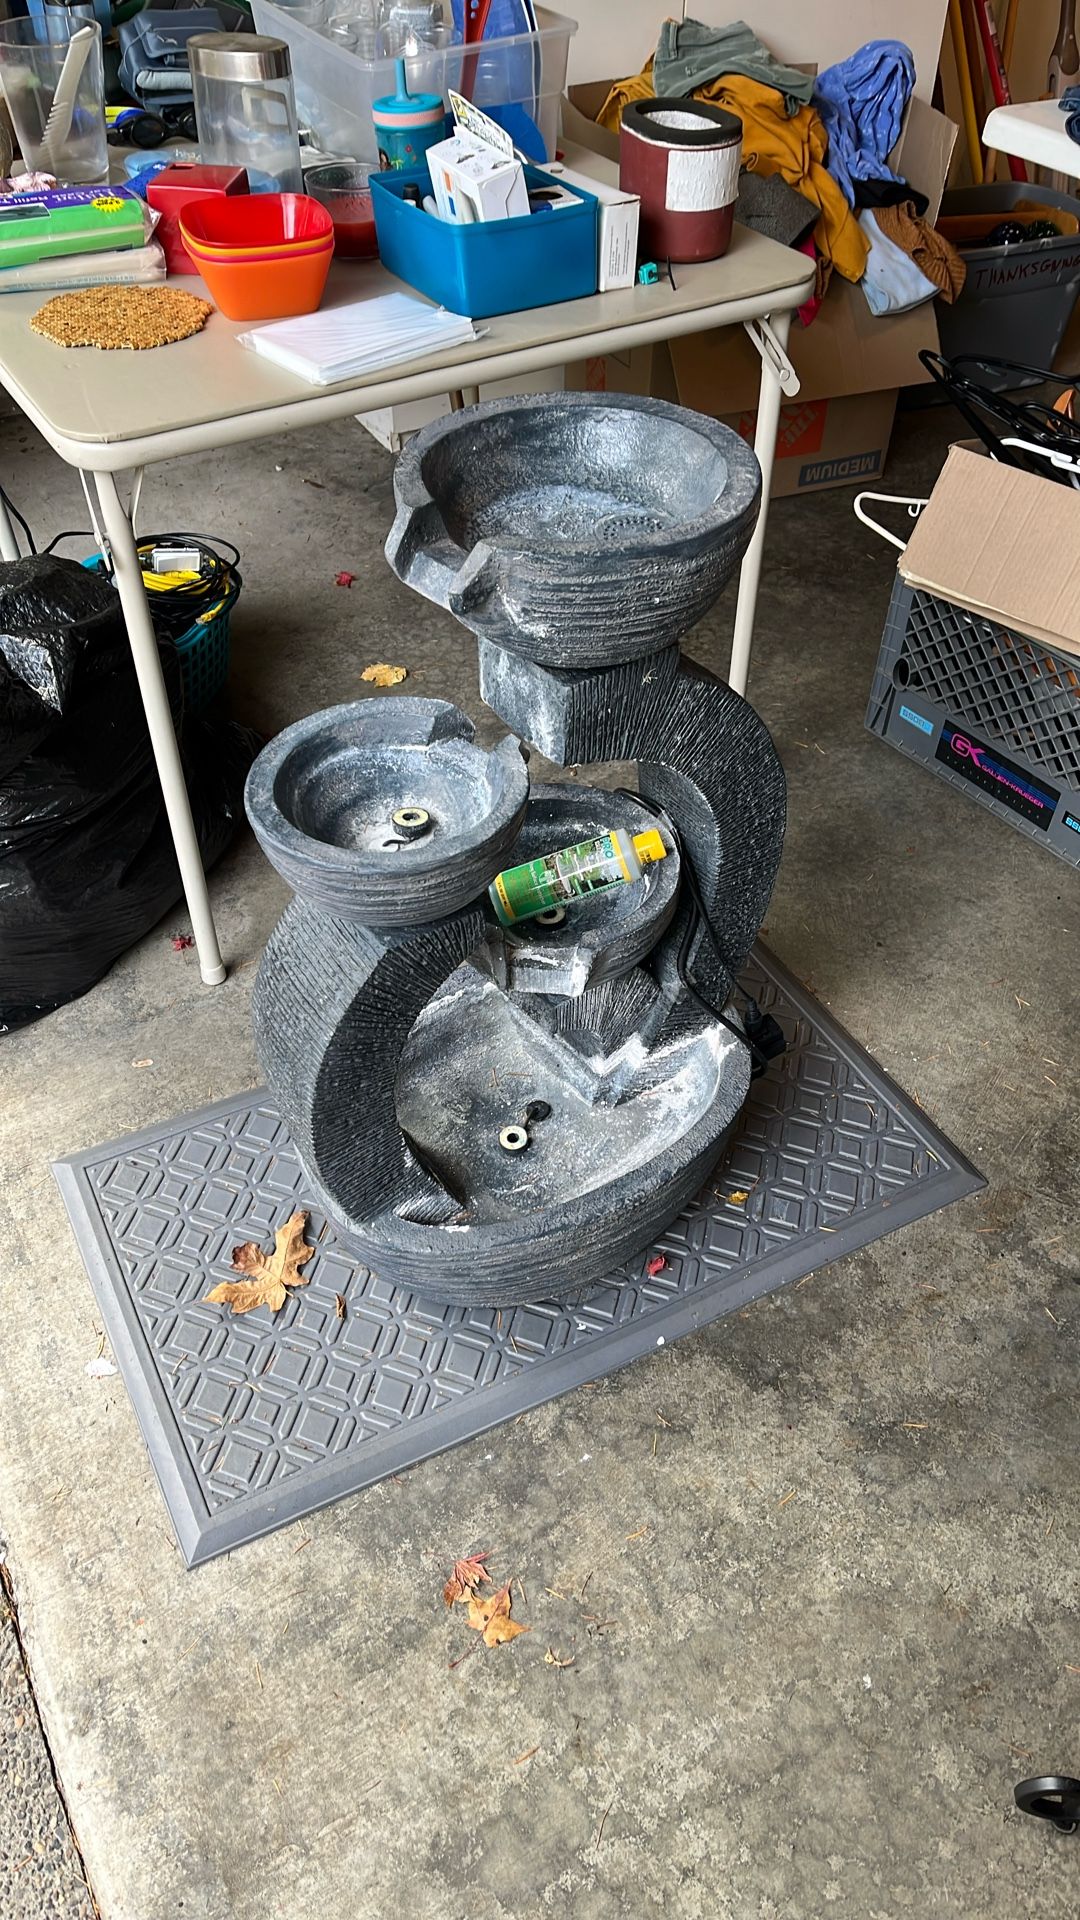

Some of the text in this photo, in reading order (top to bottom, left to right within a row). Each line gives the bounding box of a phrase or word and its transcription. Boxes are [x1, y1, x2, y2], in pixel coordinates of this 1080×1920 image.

[805, 455, 876, 482] MEDIUM
[951, 733, 986, 767] GK
[602, 836, 614, 859] PRO
